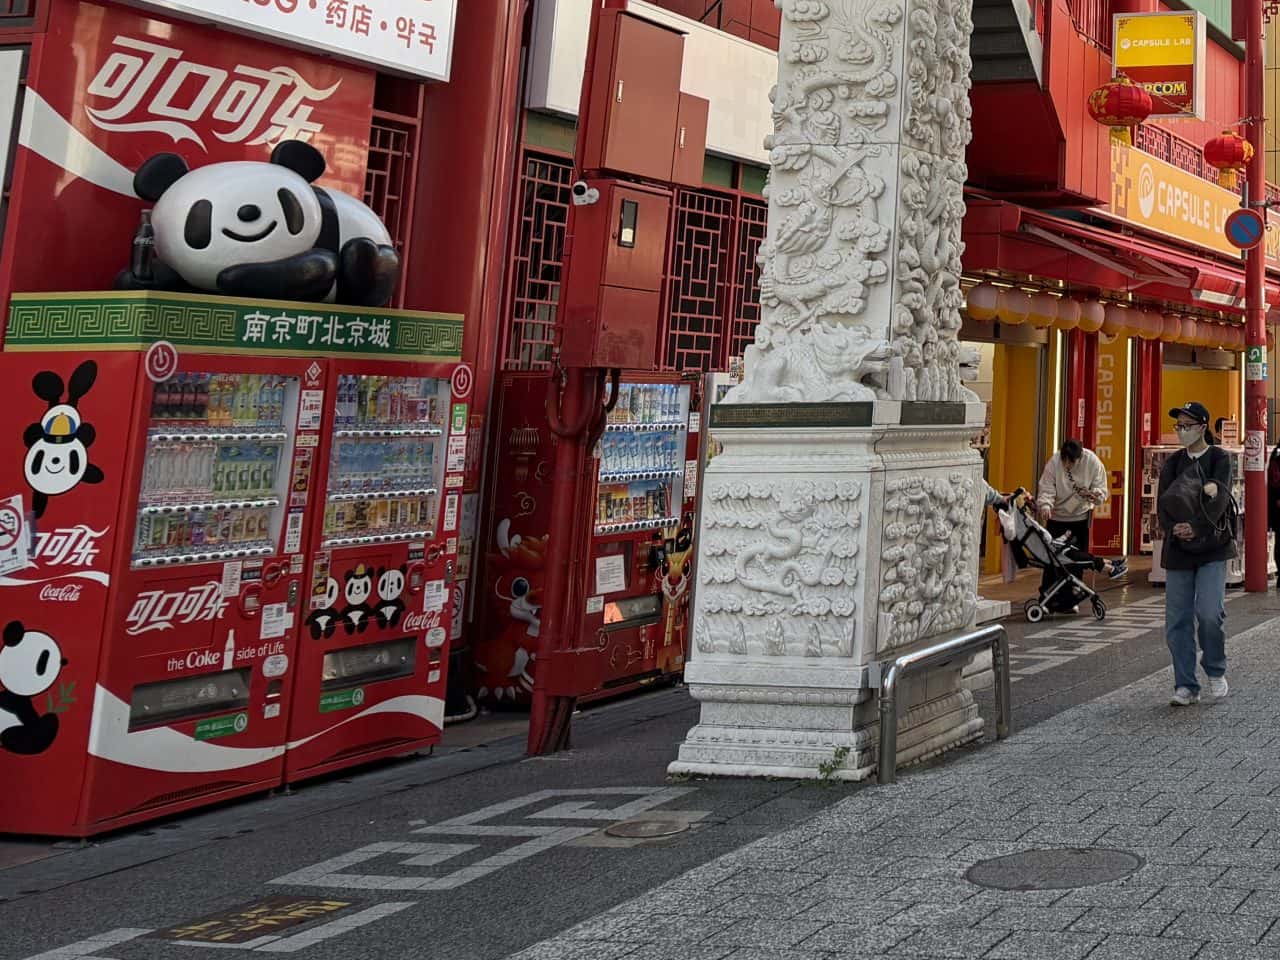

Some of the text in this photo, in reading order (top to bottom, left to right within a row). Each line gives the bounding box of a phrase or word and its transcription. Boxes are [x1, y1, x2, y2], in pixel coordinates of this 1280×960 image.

[1131, 37, 1192, 48] CAPSULE LAB
[85, 36, 342, 152] 可口可乐
[1143, 81, 1187, 96] PCOM
[1157, 180, 1211, 228] CAPSULE
[242, 311, 392, 349] 南京町北京城
[1097, 353, 1114, 460] CAPSULE
[167, 641, 285, 672] the Coke side of Life
